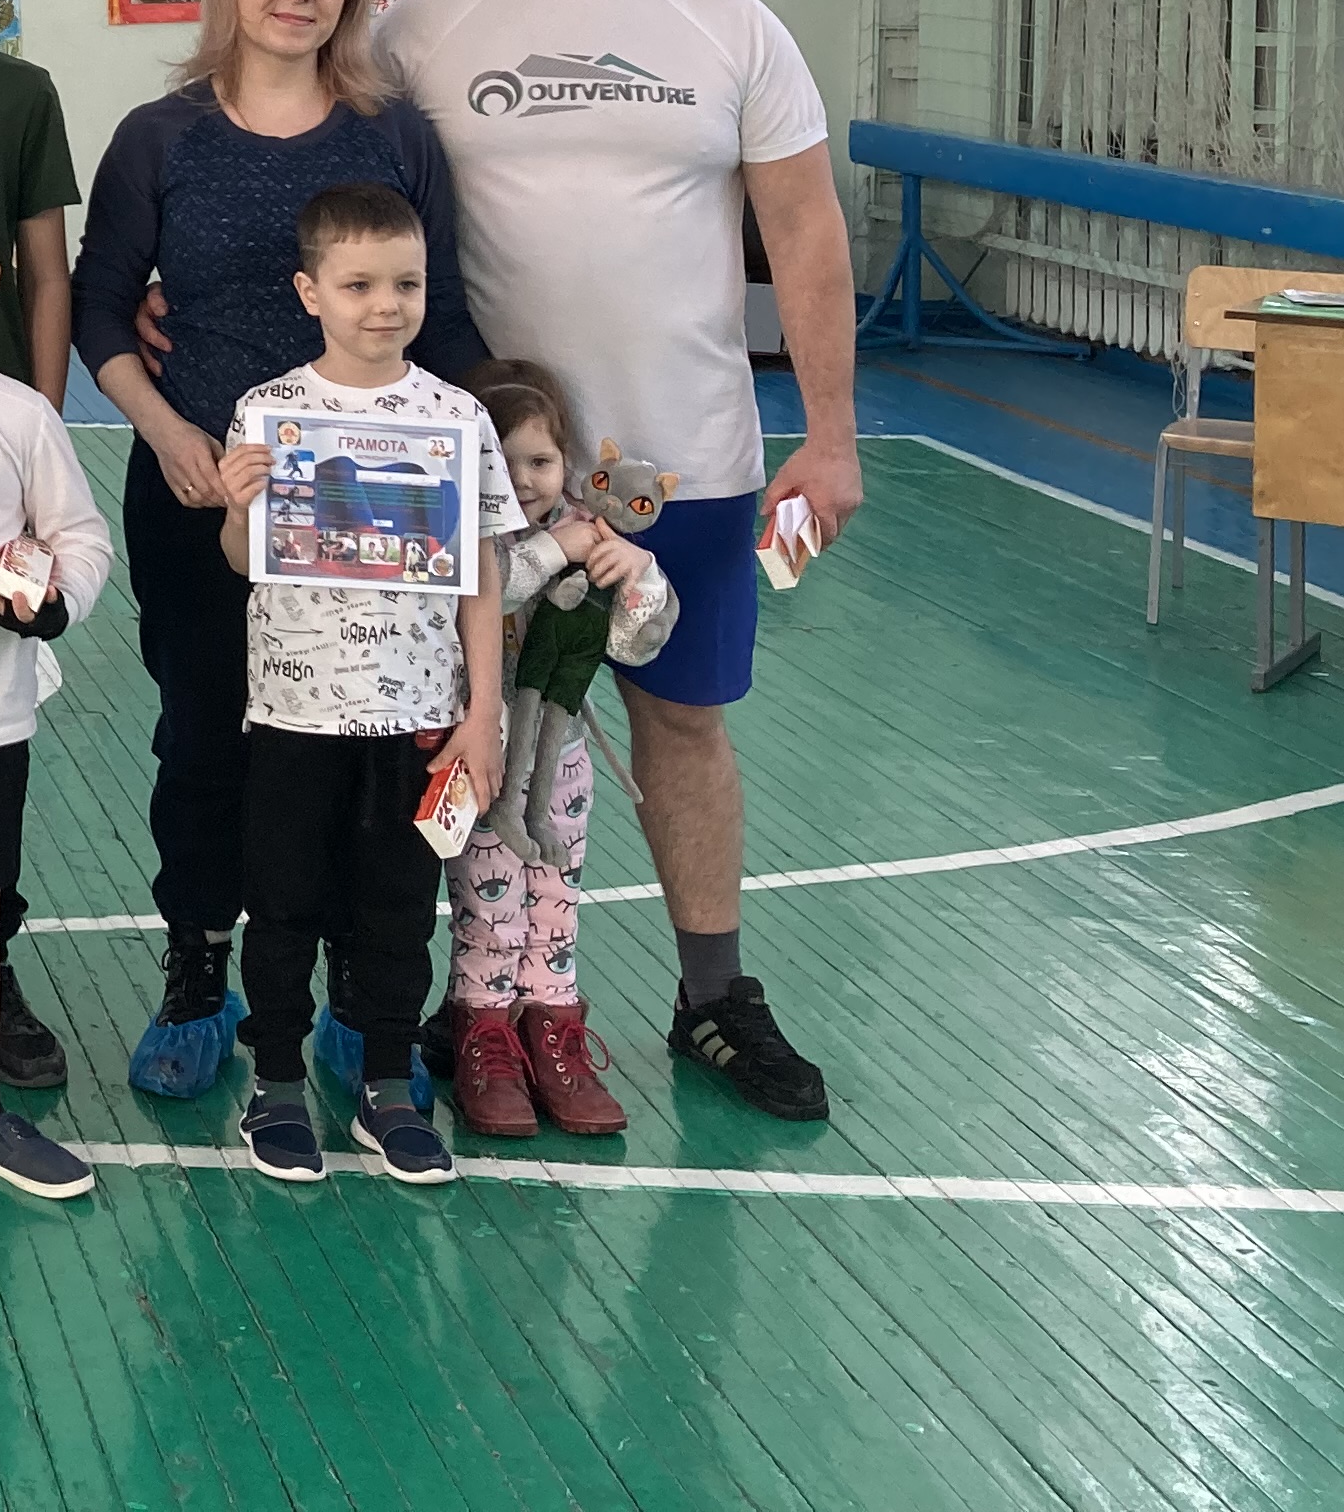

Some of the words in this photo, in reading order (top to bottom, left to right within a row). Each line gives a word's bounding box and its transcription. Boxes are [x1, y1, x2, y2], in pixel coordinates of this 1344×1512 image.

[527, 82, 697, 106] OUTVENTURE
[337, 436, 409, 454] ГРАМОТА
[430, 439, 445, 452] 23
